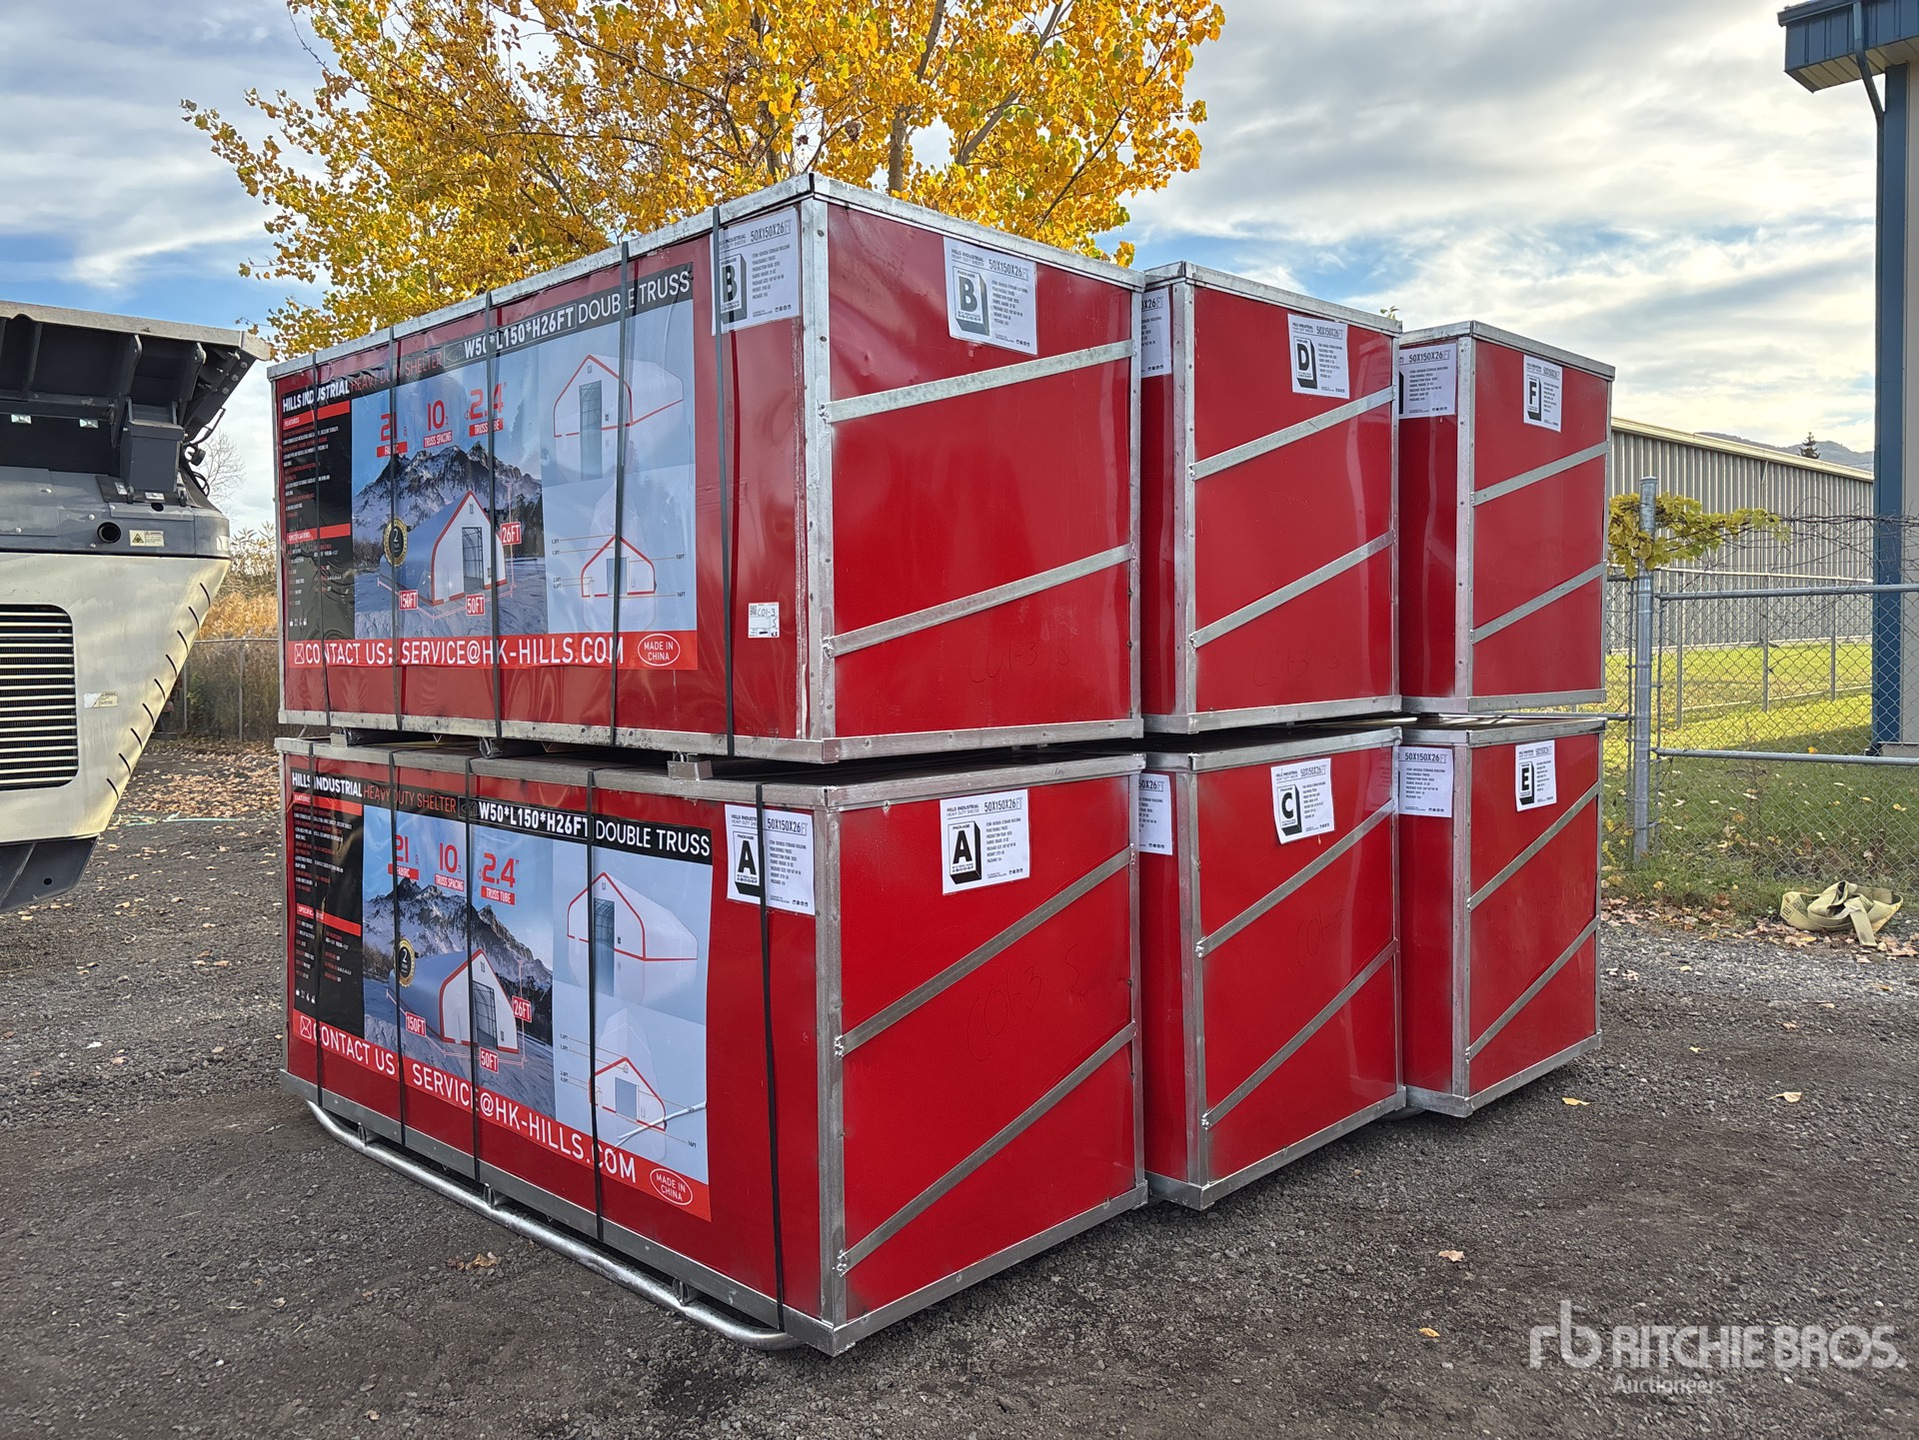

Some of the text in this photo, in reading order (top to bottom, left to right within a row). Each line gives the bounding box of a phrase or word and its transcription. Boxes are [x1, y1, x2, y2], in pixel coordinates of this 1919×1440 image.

[723, 265, 737, 303] B
[958, 276, 978, 313] B
[283, 394, 302, 413] HILLS
[404, 351, 443, 377] SHELTER
[578, 287, 635, 324] DOUBE
[639, 271, 692, 304] TRUSS
[1297, 343, 1310, 371] D
[1529, 381, 1537, 405] F
[427, 400, 445, 431] 10
[393, 528, 399, 542] 2
[502, 525, 520, 543] 26FT
[400, 593, 417, 608] 150FT
[467, 596, 484, 615] 50FT
[305, 642, 361, 664] CONTACT
[643, 640, 674, 651] MADE IN
[648, 651, 670, 661] CHINA
[1522, 767, 1530, 791] E
[292, 772, 310, 789] HILLS
[314, 775, 363, 798] INDUSTRIAL
[364, 784, 391, 801] HEAVY
[416, 793, 457, 814] SHELTER
[596, 819, 651, 848] DOUBLE
[656, 829, 710, 857] TRUSS
[1281, 792, 1294, 819] C
[439, 842, 458, 874] 10
[738, 840, 757, 875] A
[953, 830, 973, 865] A
[486, 887, 512, 903] TRUSS TUBE
[402, 949, 407, 963] 2
[514, 999, 532, 1020] 26FT
[406, 1015, 425, 1035] 150FT
[481, 1051, 498, 1071] 50FT
[656, 1172, 686, 1194] MADE IN
[660, 1184, 683, 1202] CHINA
